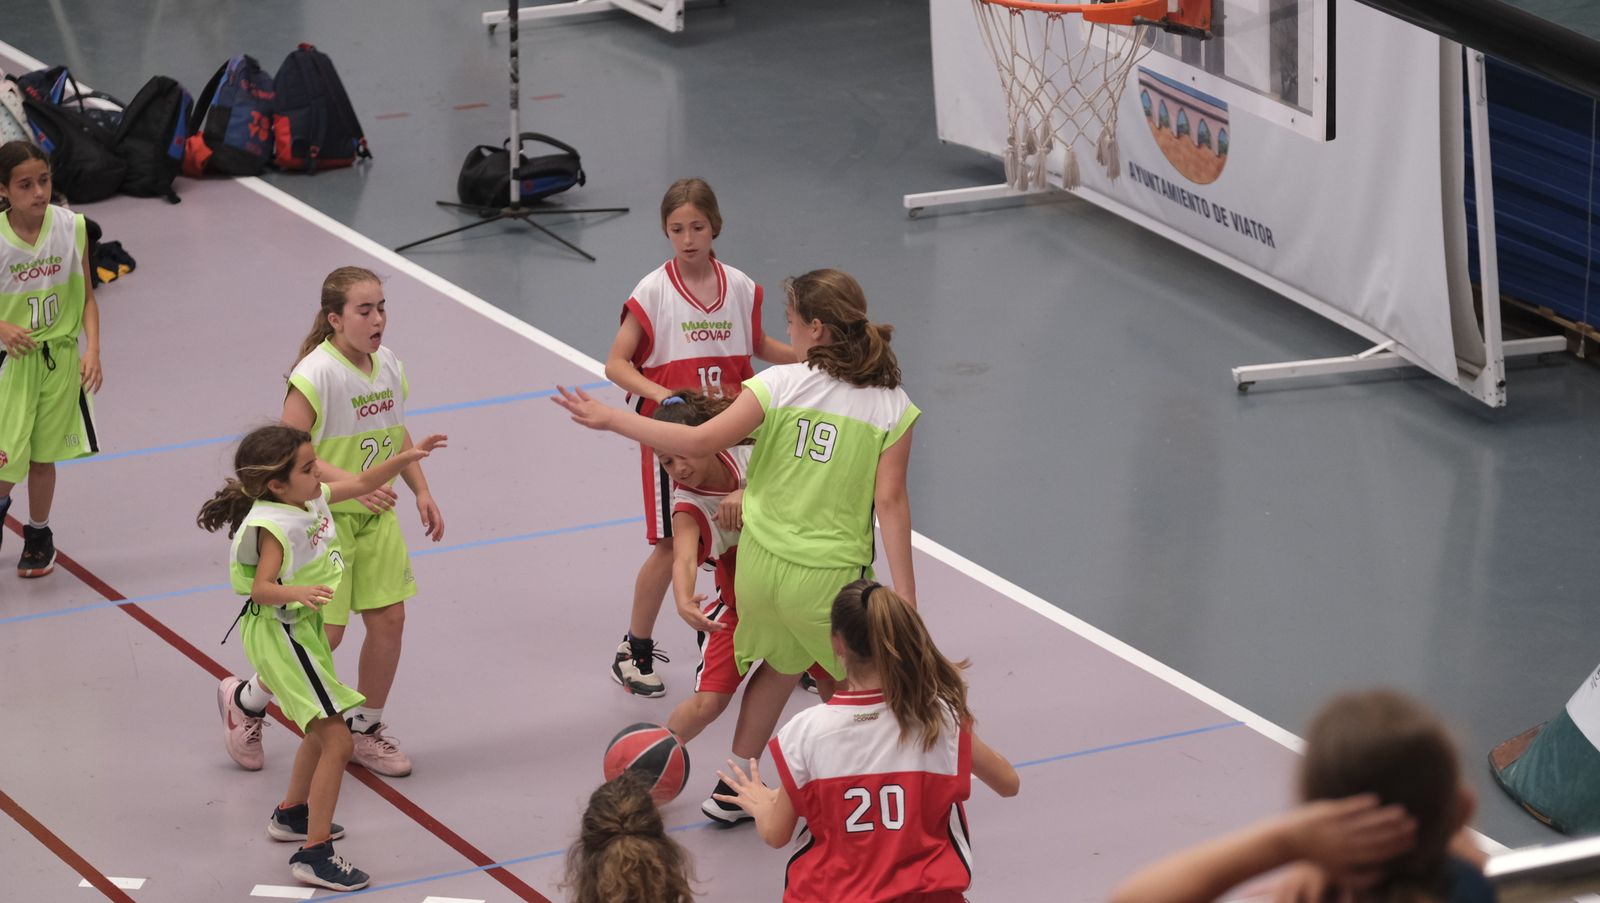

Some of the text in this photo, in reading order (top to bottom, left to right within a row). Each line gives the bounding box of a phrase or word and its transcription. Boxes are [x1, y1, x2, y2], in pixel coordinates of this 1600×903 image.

[1128, 161, 1276, 249] AYUNTAMIENTO DE VIATOR
[27, 293, 59, 331] 10
[681, 320, 733, 332] Muévete
[691, 329, 731, 342] COVAP
[698, 366, 724, 400] 19
[360, 399, 394, 417] COAP
[794, 418, 838, 464] 19
[843, 784, 905, 834] 20
